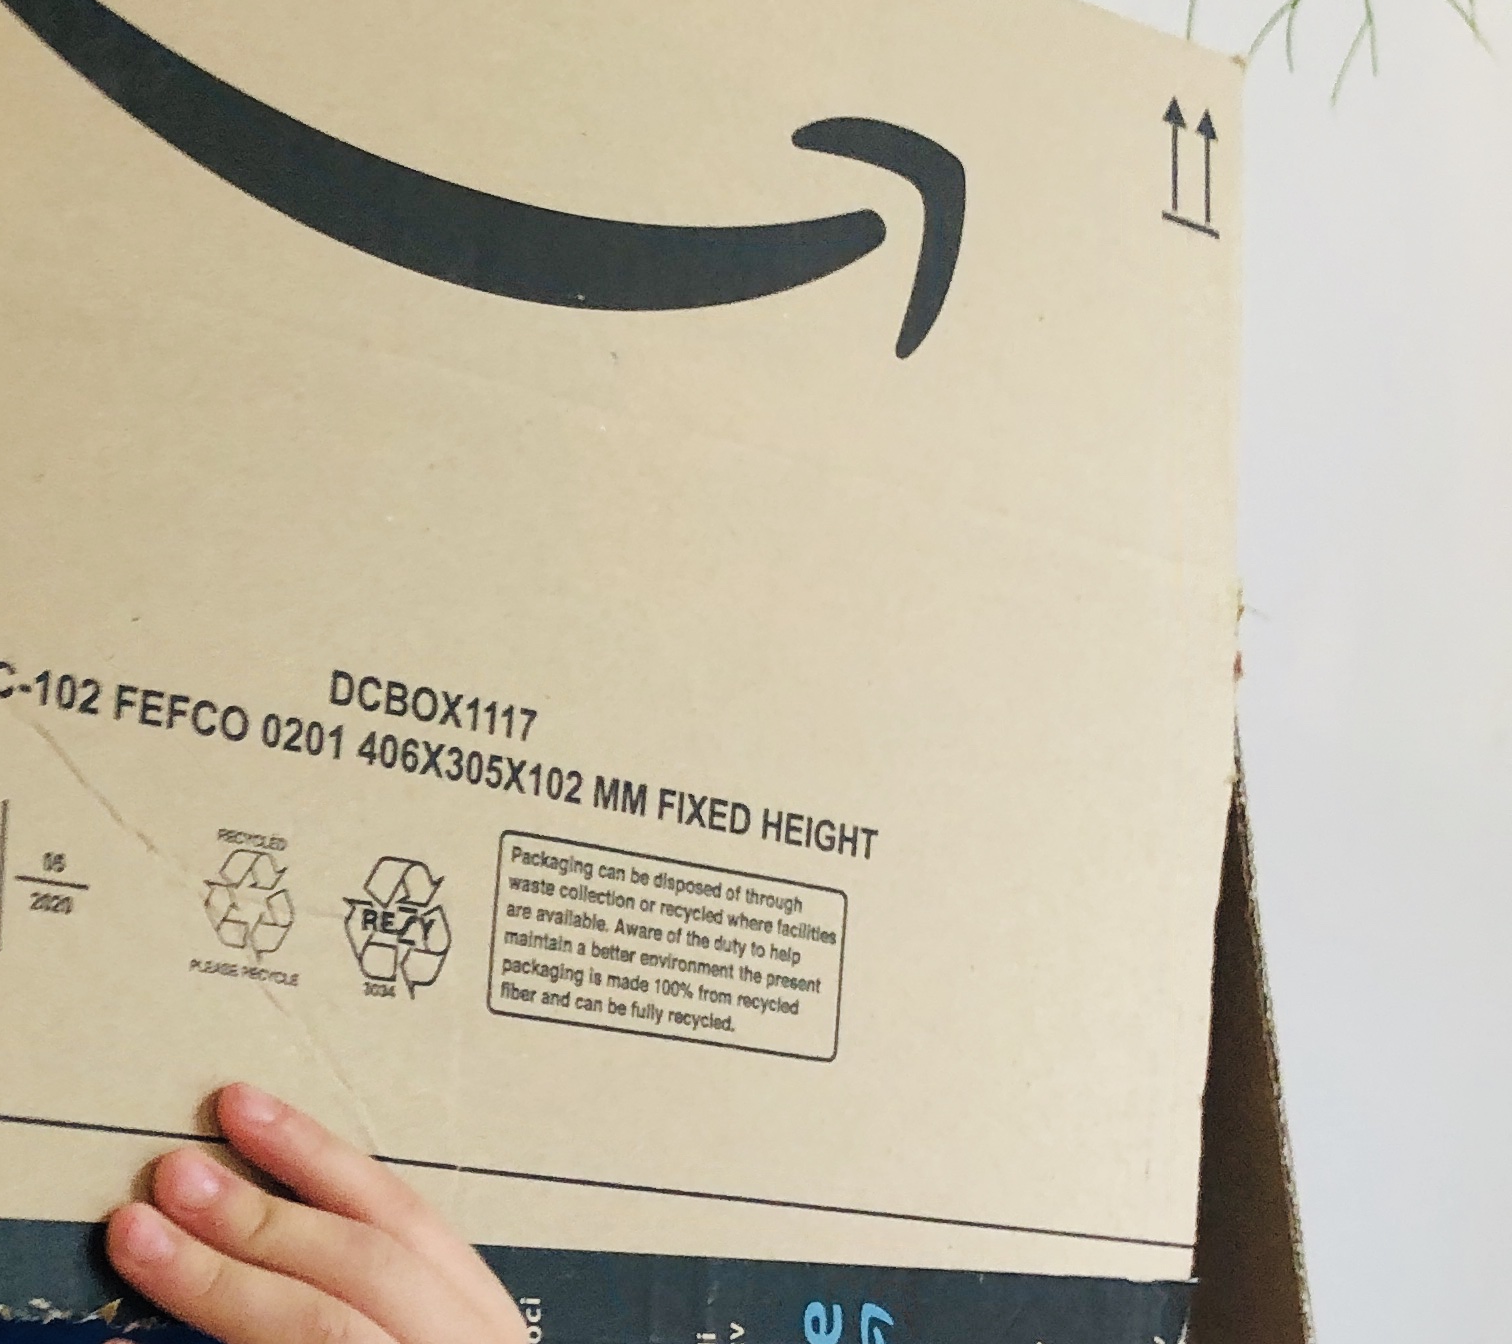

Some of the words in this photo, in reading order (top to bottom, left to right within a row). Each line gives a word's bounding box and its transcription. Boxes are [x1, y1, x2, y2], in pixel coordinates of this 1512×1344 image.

[329, 669, 538, 742] DCBOX1117
[113, 683, 249, 742] FEFCO
[261, 713, 344, 761] 0201
[358, 731, 583, 805] 406X305X102
[593, 775, 647, 819] MM
[657, 789, 751, 835] FIXED
[762, 808, 879, 860] HEIGHT
[218, 828, 288, 851] RECYCLED
[508, 877, 554, 896] waste
[559, 884, 635, 910] collection
[639, 899, 656, 912] or
[660, 903, 723, 924] recycled
[727, 912, 773, 934] where
[777, 919, 836, 945] facilities
[511, 846, 593, 880] Packaging
[598, 864, 625, 881] can
[630, 867, 649, 886] be
[653, 873, 722, 898] disposed
[726, 886, 741, 901] of
[746, 888, 803, 915] through
[504, 930, 572, 953] maintain
[577, 942, 586, 955] a
[591, 941, 636, 963] better
[640, 952, 734, 979] environment
[739, 965, 762, 984] the
[766, 972, 821, 994] present
[506, 903, 532, 919] are
[537, 908, 608, 932] available.
[614, 918, 662, 941] Aware
[667, 928, 682, 943] of
[686, 930, 710, 948] the
[714, 935, 747, 958] duty
[751, 942, 765, 958] to
[770, 944, 801, 966] help
[241, 964, 299, 987] RECYCLE
[500, 980, 537, 1003] fiber
[541, 991, 571, 1007] and
[575, 996, 603, 1013] can
[608, 997, 627, 1016] be
[631, 1002, 663, 1025] fully
[668, 1010, 735, 1032] recycled.
[501, 958, 584, 987] packaging
[589, 967, 602, 986] is
[607, 974, 649, 992] made
[654, 978, 693, 999] 100%
[698, 984, 732, 1005] from
[737, 994, 799, 1015] recycled
